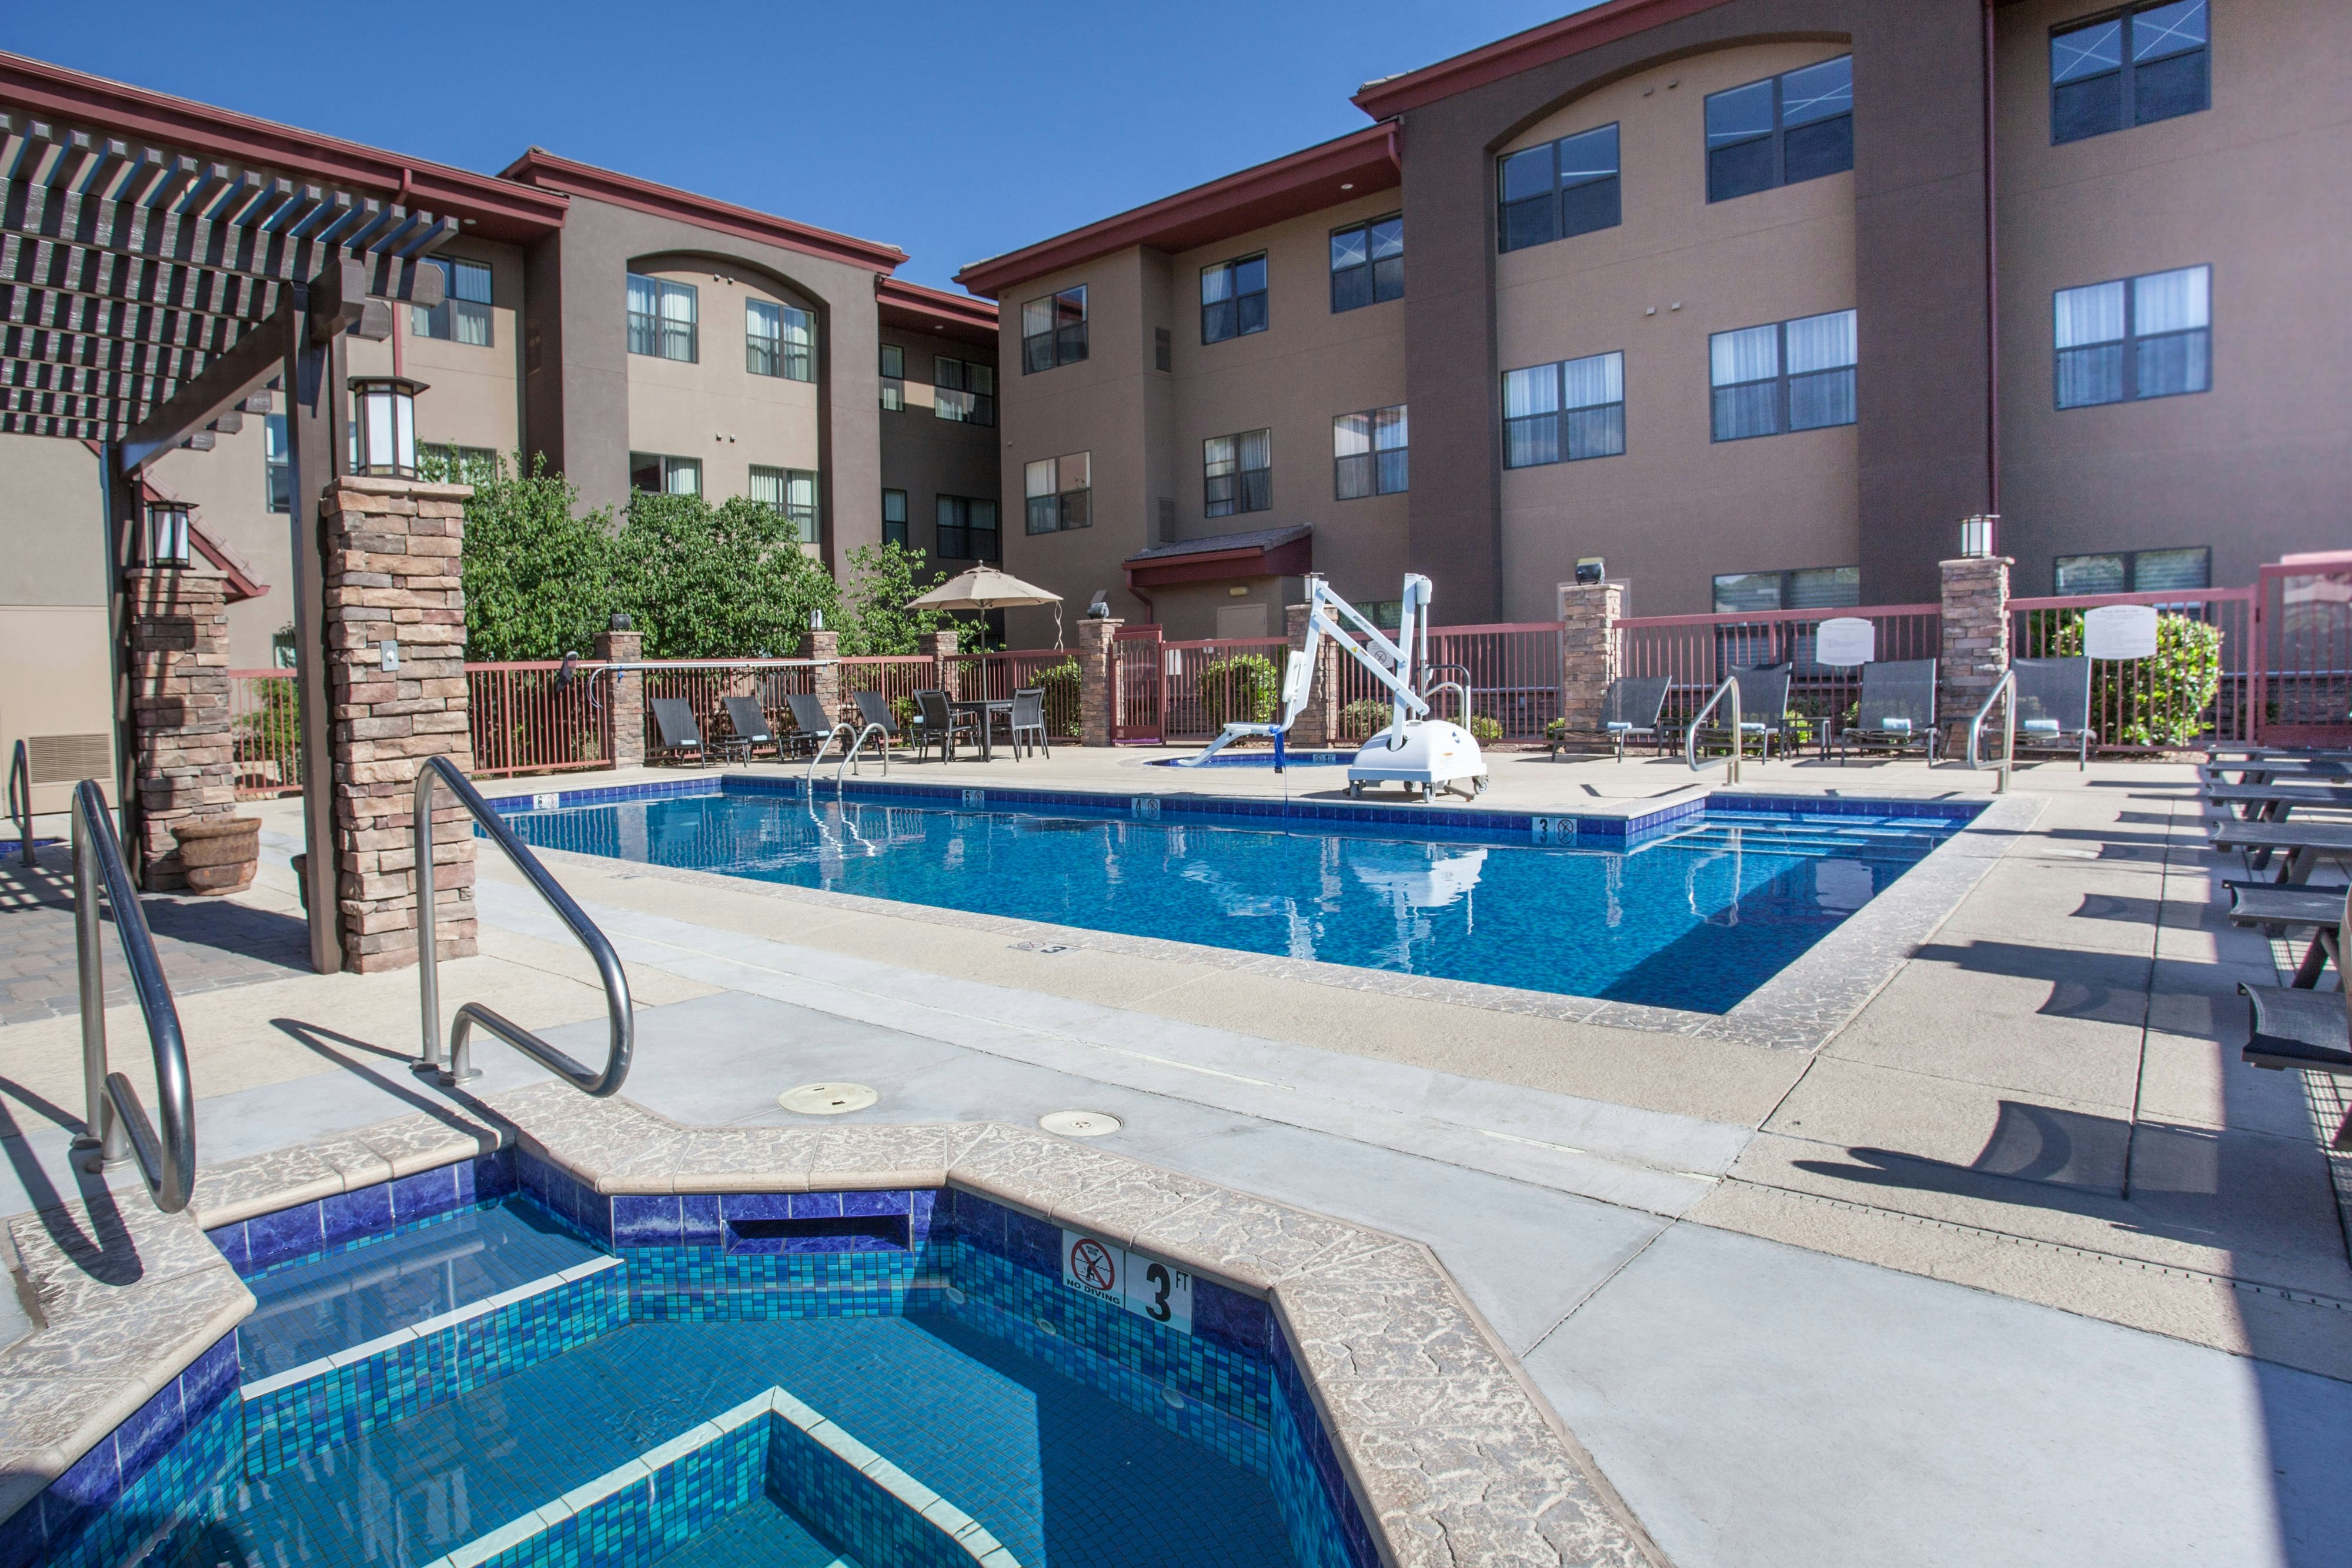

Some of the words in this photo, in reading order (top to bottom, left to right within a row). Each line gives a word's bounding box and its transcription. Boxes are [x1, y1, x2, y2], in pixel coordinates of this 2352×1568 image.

[538, 795, 542, 804] 6
[965, 790, 970, 801] 5
[1136, 799, 1141, 809] 4
[1539, 818, 1548, 832] 3
[1067, 1279, 1081, 1289] NO
[1084, 1286, 1120, 1304] DIVING
[1145, 1263, 1171, 1322] 3
[1176, 1270, 1188, 1291] FT
